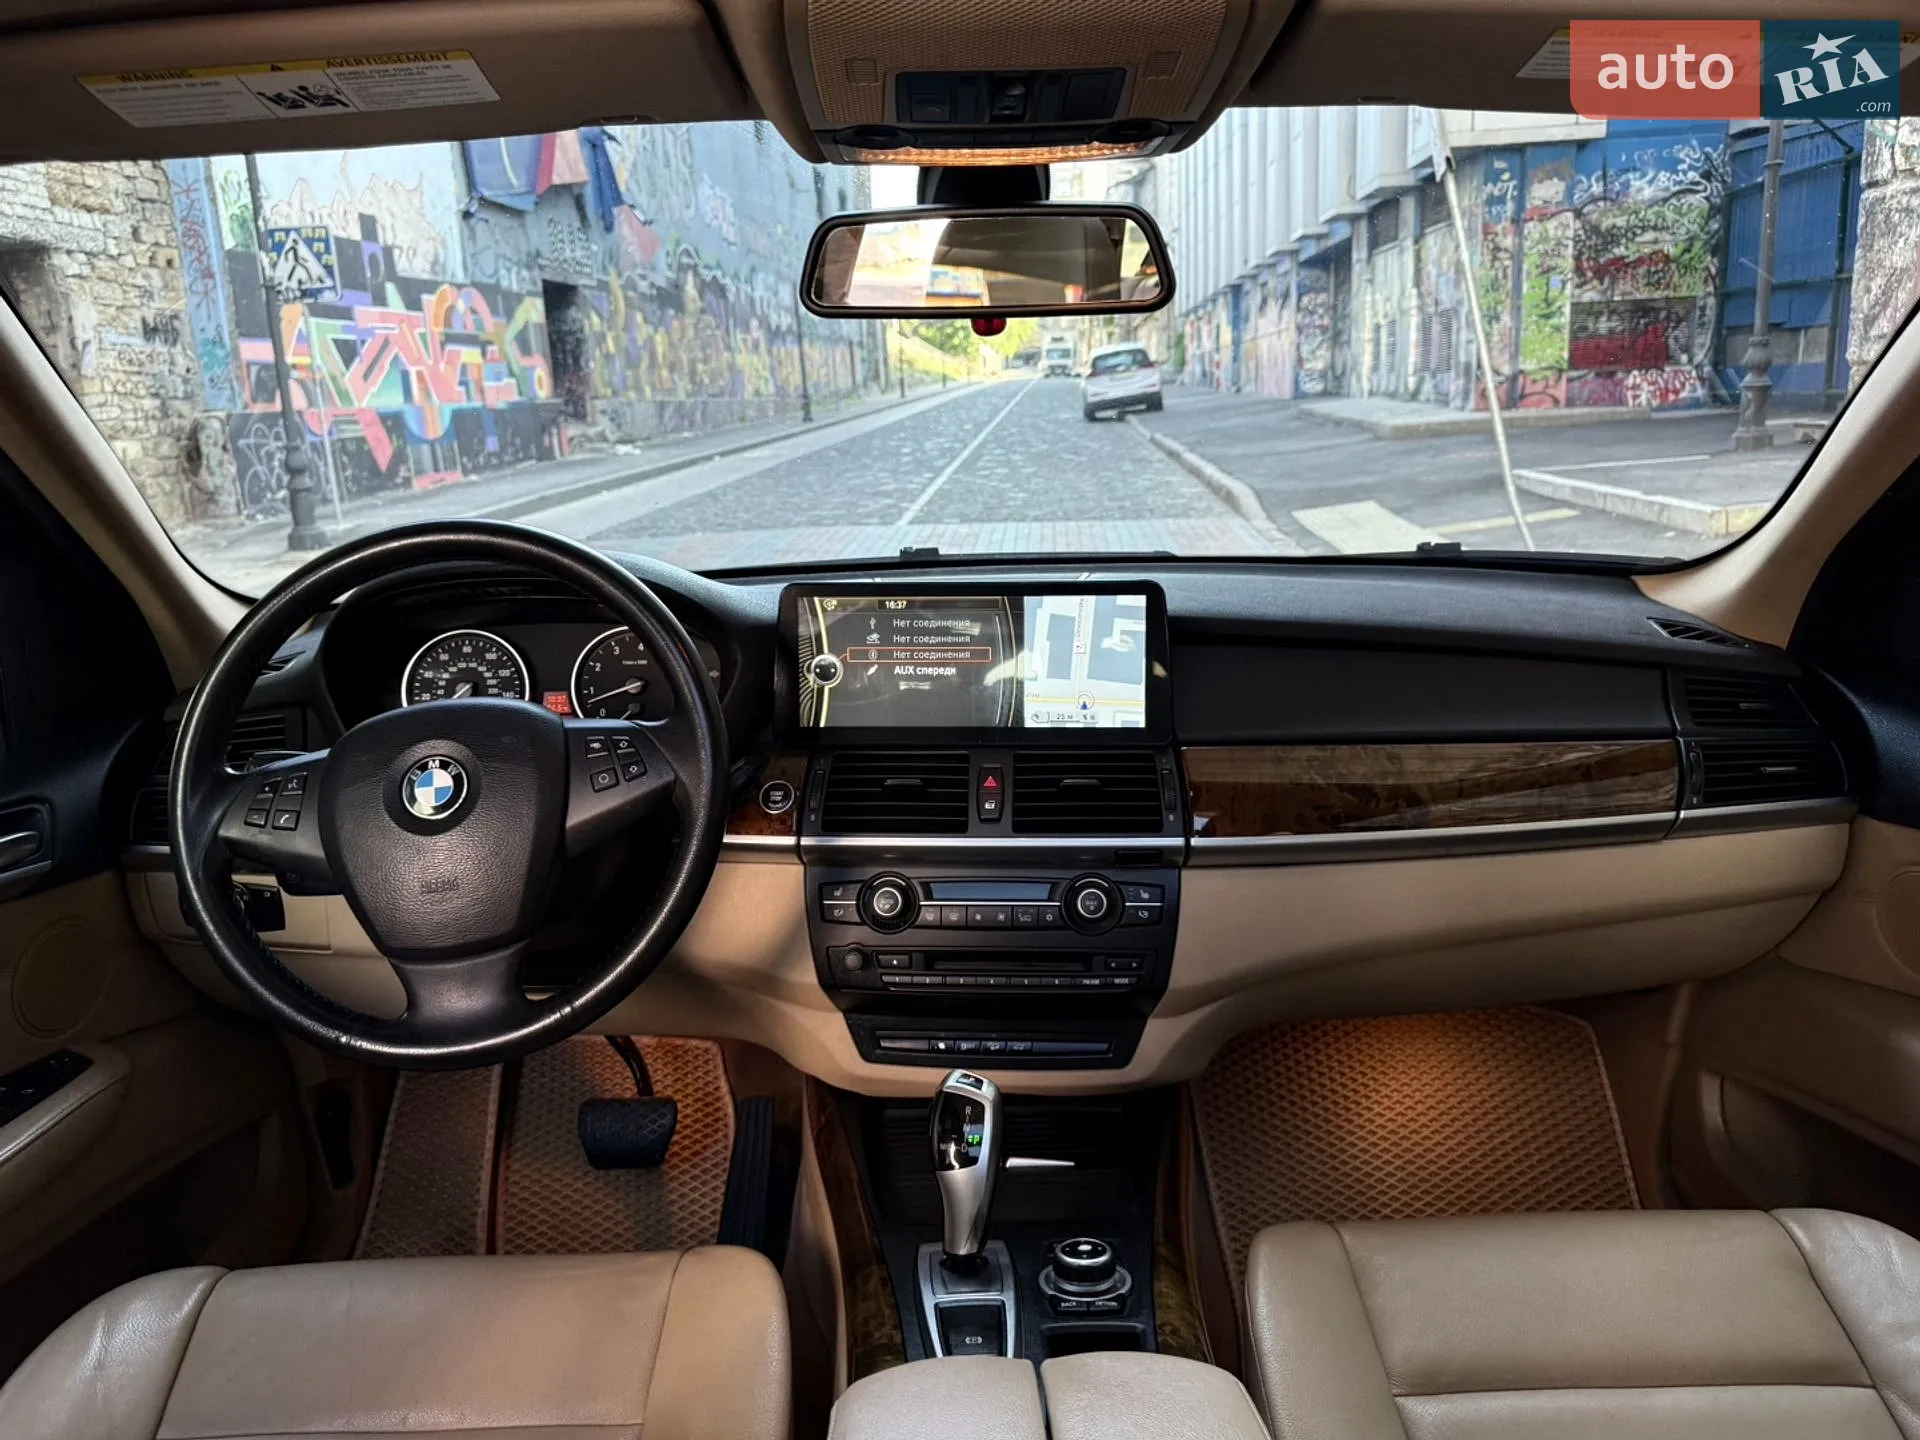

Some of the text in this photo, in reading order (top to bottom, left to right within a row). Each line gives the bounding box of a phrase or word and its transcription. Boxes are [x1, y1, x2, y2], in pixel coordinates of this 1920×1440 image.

[326, 52, 449, 69] AVERTISSEMENT
[116, 69, 193, 82] WARNING
[885, 600, 907, 610] 16:37
[893, 619, 971, 629] Нет соединения
[893, 635, 971, 645] Нет соединения
[613, 645, 621, 655] 3
[893, 651, 971, 661] Нет соединения
[594, 661, 602, 671] 2
[894, 666, 957, 677] AUX спереди
[600, 707, 607, 717] 0
[410, 759, 461, 780] BMW
